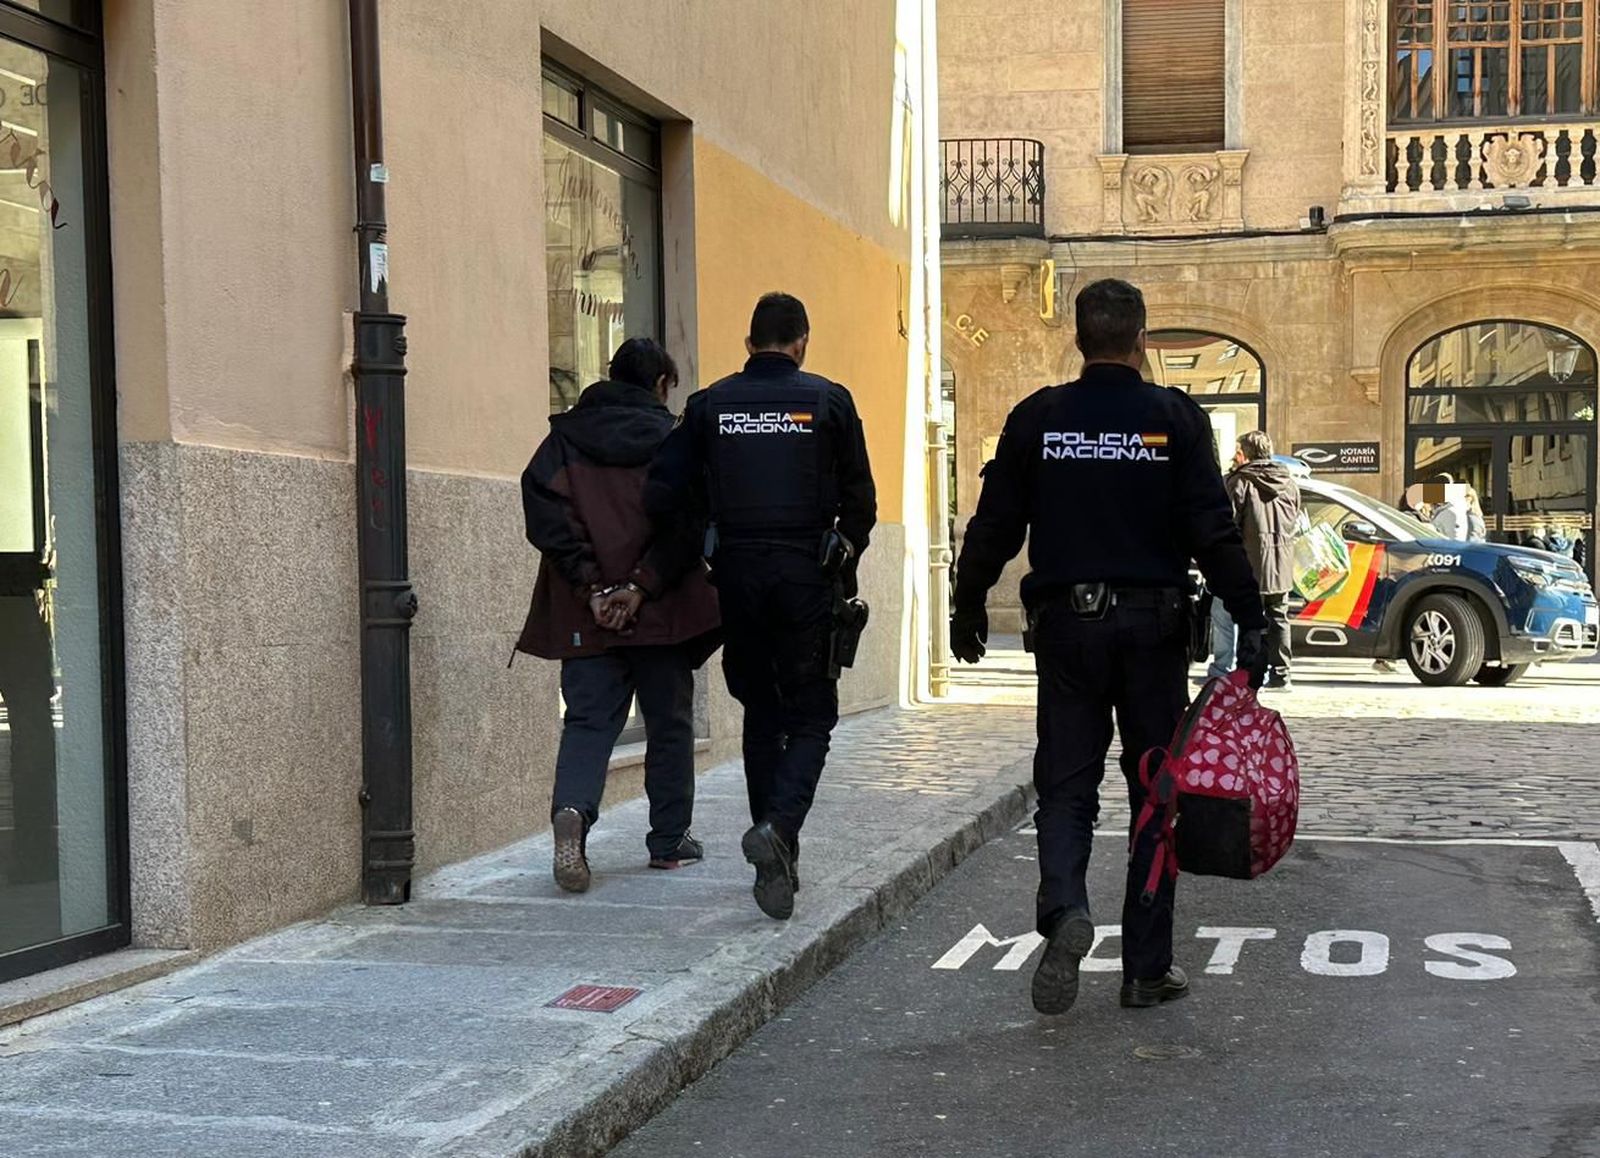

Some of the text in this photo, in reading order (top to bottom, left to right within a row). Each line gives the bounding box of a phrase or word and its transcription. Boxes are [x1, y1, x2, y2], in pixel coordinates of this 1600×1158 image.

[719, 412, 793, 424] POLICIA
[719, 423, 813, 435] NACIONAL
[1043, 431, 1144, 446] POLICIA
[1042, 446, 1169, 461] NACIONAL
